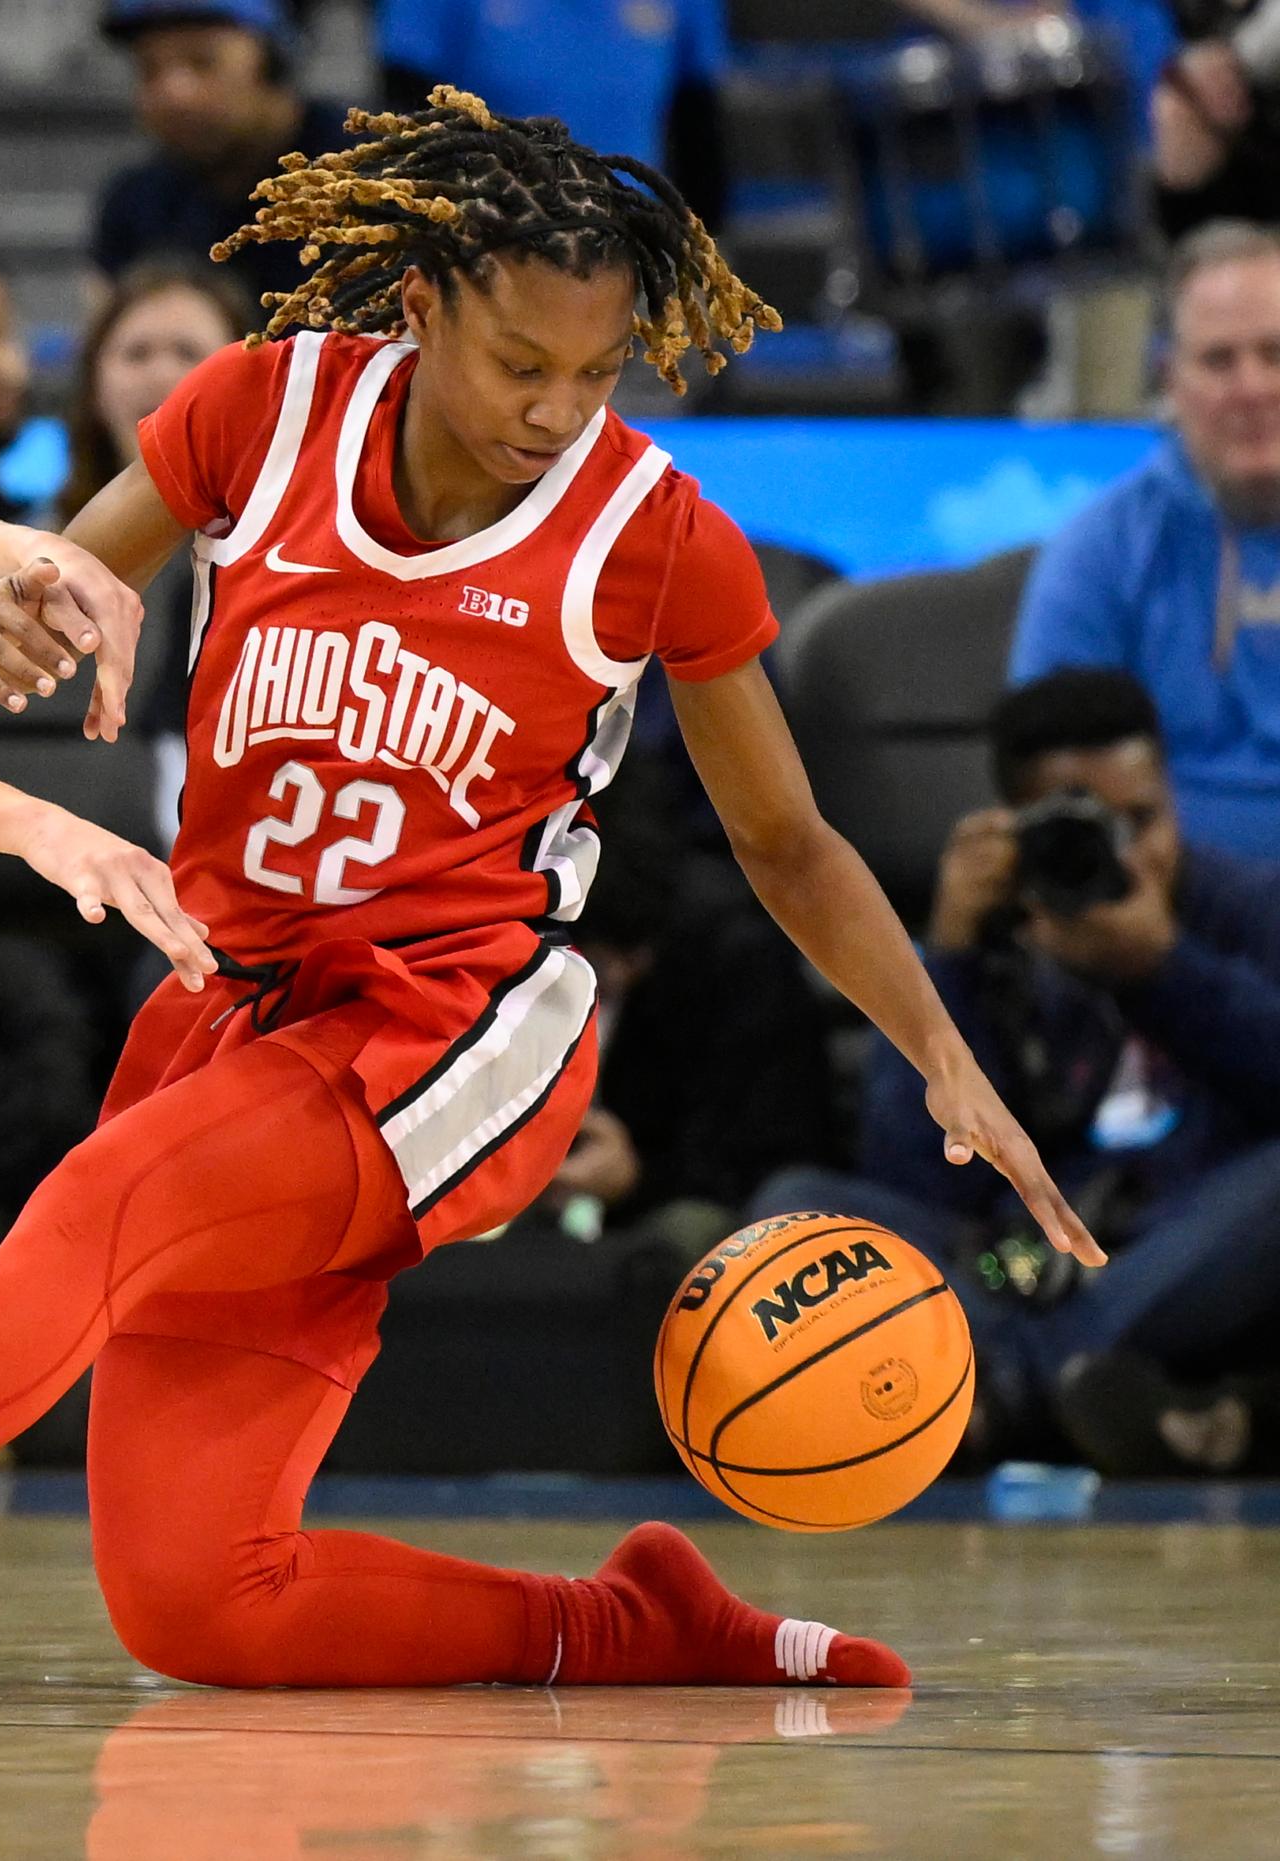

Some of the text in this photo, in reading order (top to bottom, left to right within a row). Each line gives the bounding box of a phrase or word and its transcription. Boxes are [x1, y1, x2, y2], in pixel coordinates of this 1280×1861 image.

[213, 620, 517, 831] OHIO STATE
[243, 759, 406, 906] 22
[749, 1239, 894, 1343] NCAA
[773, 1309, 829, 1353] OFFICIAL
[829, 1285, 868, 1310] GAME
